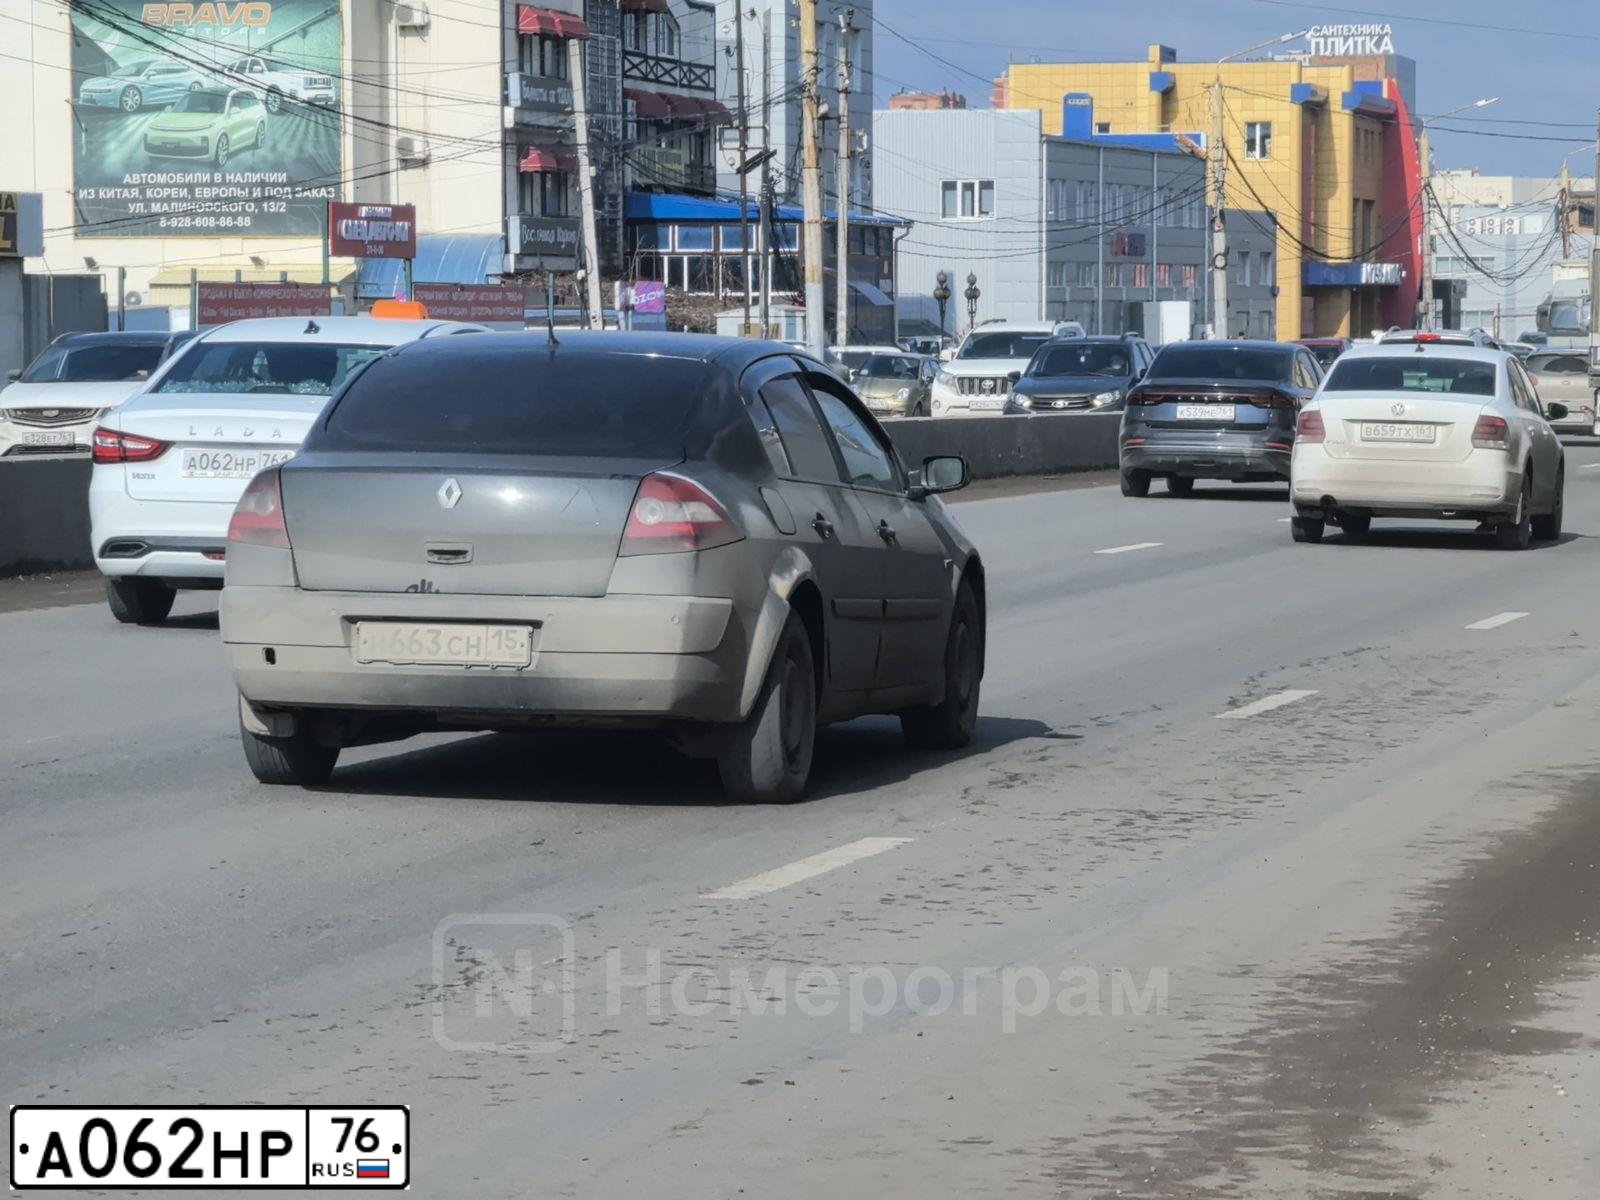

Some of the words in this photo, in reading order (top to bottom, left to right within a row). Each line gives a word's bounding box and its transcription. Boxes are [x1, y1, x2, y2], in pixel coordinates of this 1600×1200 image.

[141, 2, 272, 26] BRAVO
[1311, 24, 1392, 37] САНТЕХНИКА
[1311, 35, 1395, 56] ПЛИТКА
[123, 173, 210, 184] АВТОМОБИЛИ
[214, 173, 223, 183] В
[226, 172, 287, 183] НАЛИЧИИ
[79, 189, 96, 199] ИЗ
[99, 188, 143, 200] КИТАЯ,
[146, 188, 191, 200] КОРЕИ,
[195, 187, 249, 198] ЕВРОПЫ
[253, 188, 261, 198] И
[265, 187, 292, 199] ПОД
[295, 187, 335, 198] ЗАКАЗ
[128, 203, 147, 213] УЛ.
[151, 202, 258, 213] МАЛИНОВСКОГО,
[262, 202, 287, 212] 13/2
[160, 217, 251, 227] 8-928-608-86-88
[189, 426, 282, 438] LADA
[1365, 424, 1412, 437] В659ТХ
[1414, 425, 1433, 435] 161
[187, 453, 256, 471] А062НР
[491, 629, 518, 651] 15
